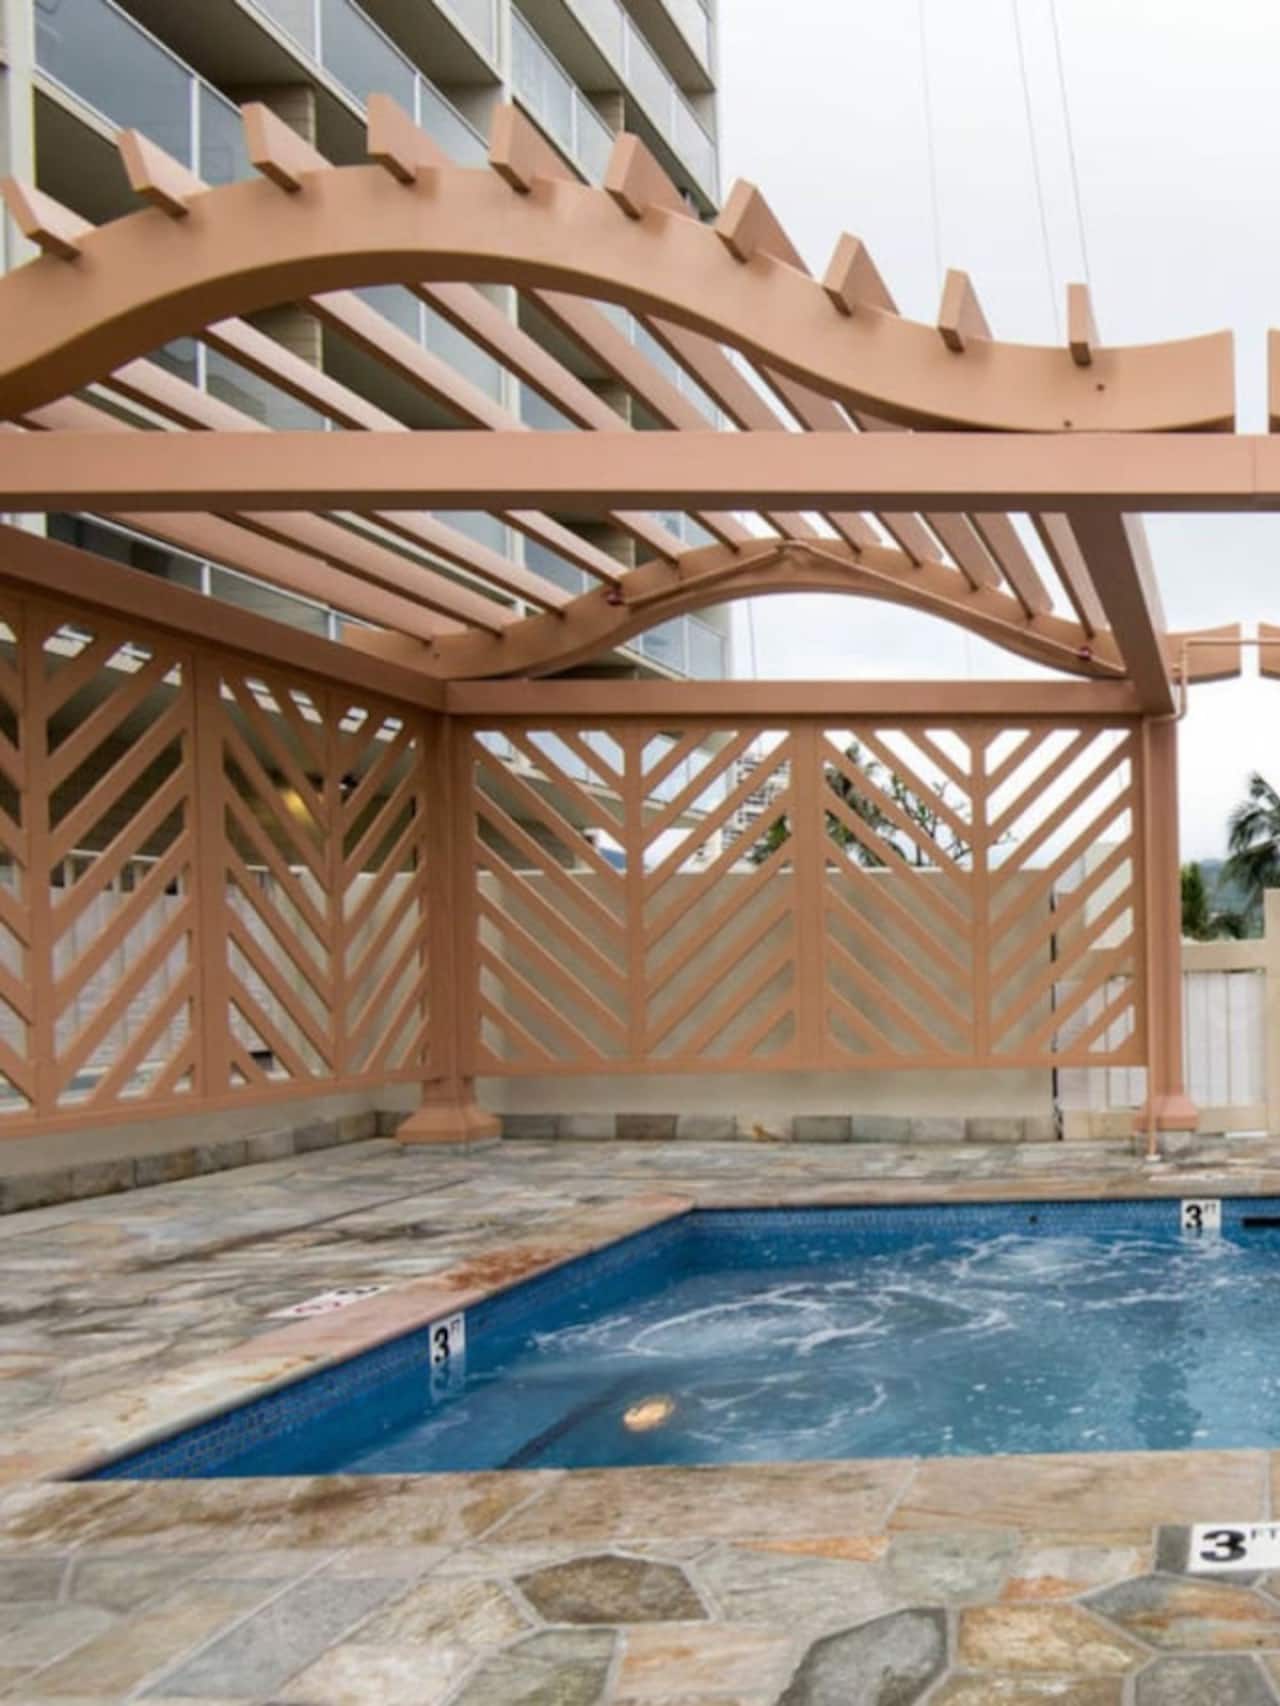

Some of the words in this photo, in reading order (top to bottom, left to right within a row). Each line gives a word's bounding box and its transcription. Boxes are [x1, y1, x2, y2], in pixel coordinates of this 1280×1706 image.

[1186, 1204, 1203, 1231] 3
[434, 1326, 450, 1364] 3
[1200, 1529, 1248, 1562] 3
[1251, 1527, 1280, 1541] FT
